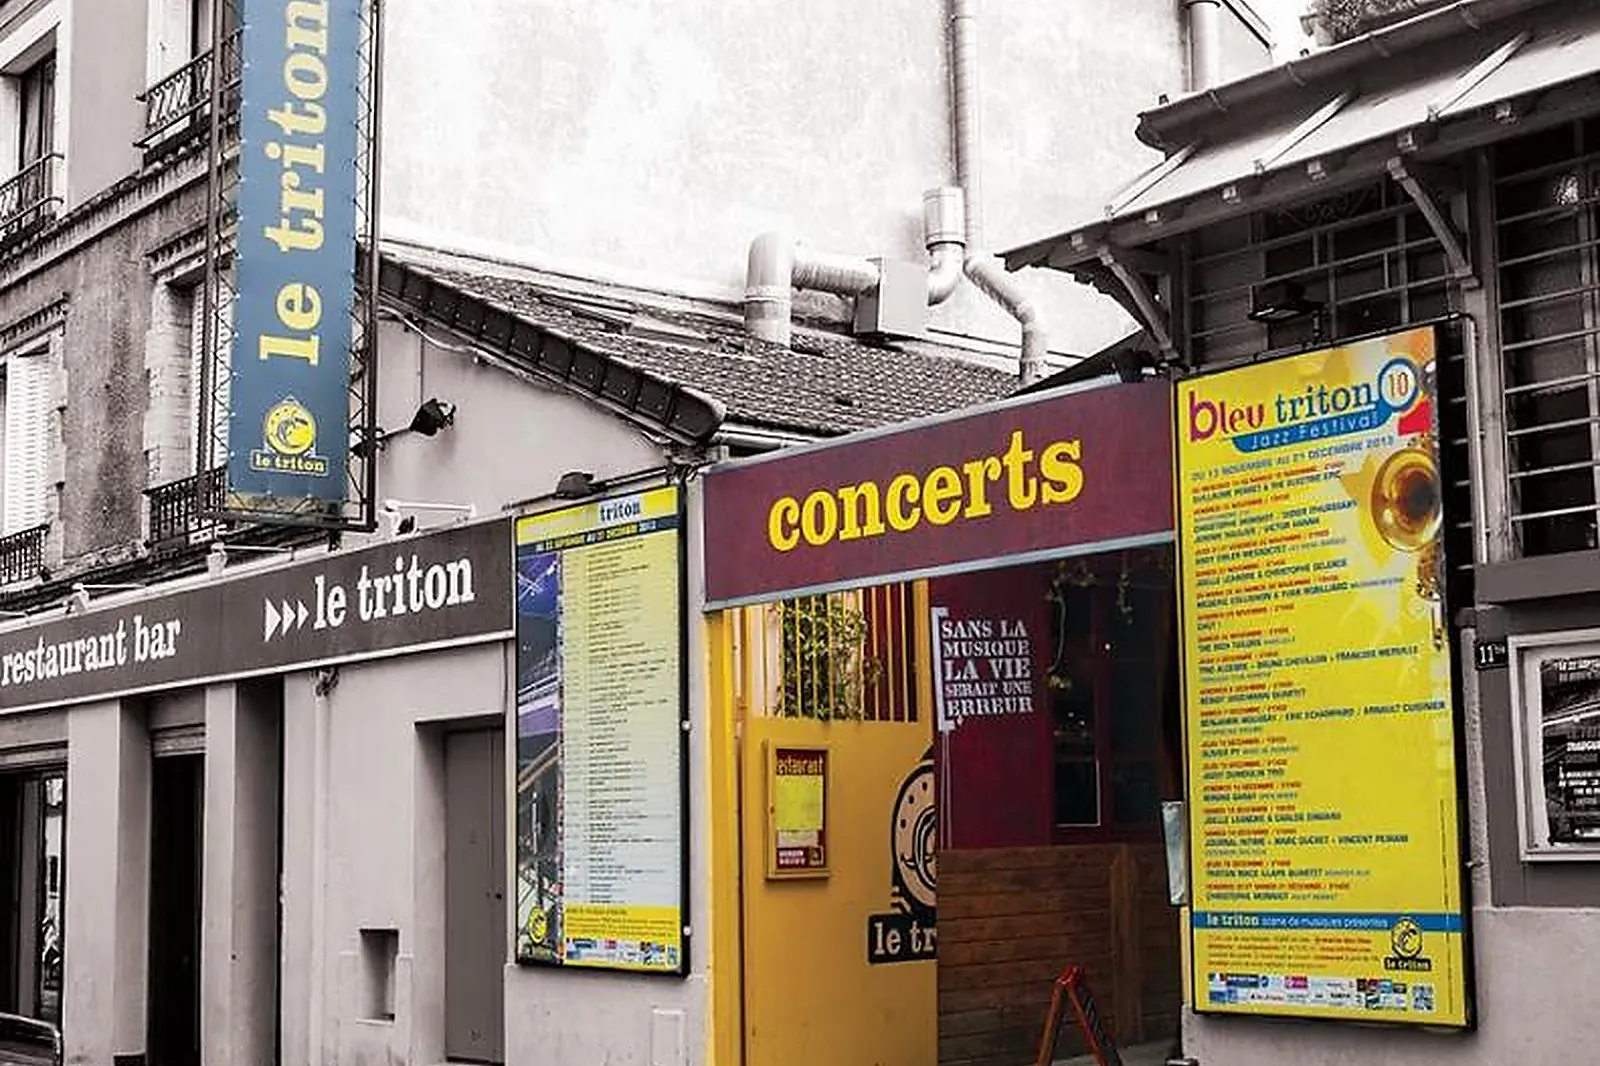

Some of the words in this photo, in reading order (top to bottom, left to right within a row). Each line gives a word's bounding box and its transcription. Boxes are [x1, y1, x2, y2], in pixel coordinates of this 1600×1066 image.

[263, 0, 328, 252] triton
[260, 283, 322, 366] le
[1276, 383, 1372, 423] triton
[1299, 414, 1379, 438] Festival
[769, 430, 1084, 552] concerts
[600, 499, 641, 522] triton
[315, 574, 346, 630] le
[357, 553, 475, 622] triton
[941, 620, 993, 639] SANS
[1000, 620, 1027, 638] LA
[1, 619, 127, 687] restaurant
[134, 615, 180, 662] bar
[943, 640, 1030, 658] MUSIQUE
[943, 659, 979, 680] LA
[989, 657, 1031, 679] VIE
[945, 682, 997, 698] SERAIT
[1002, 681, 1032, 695] UNE
[946, 697, 1034, 716] ERREUR
[1222, 913, 1259, 927] triton
[874, 921, 901, 955] le
